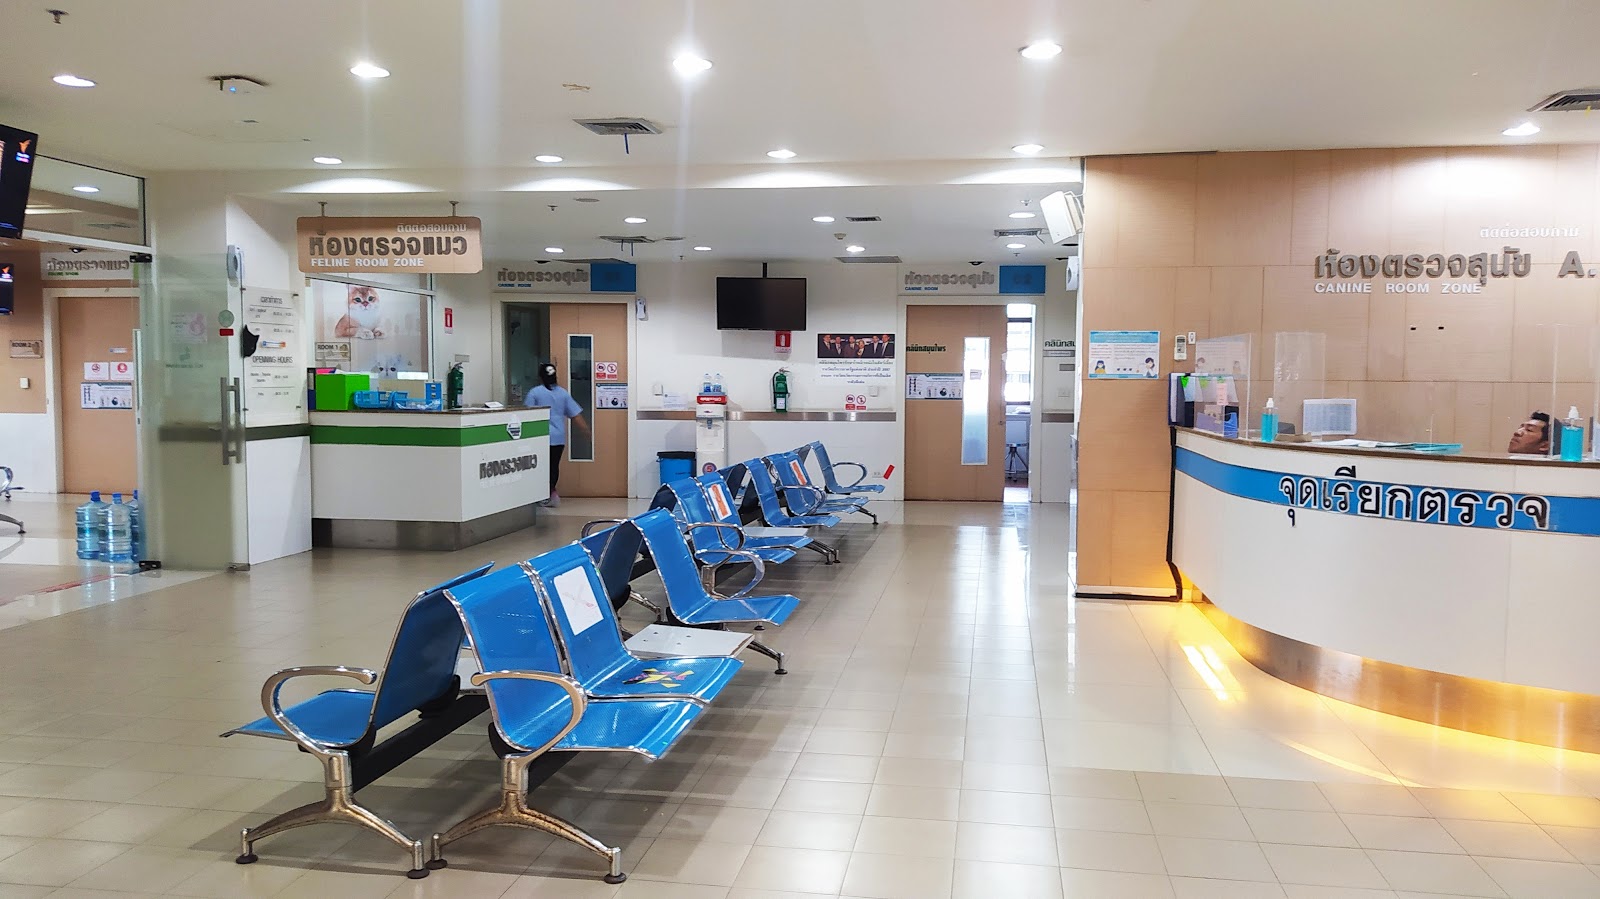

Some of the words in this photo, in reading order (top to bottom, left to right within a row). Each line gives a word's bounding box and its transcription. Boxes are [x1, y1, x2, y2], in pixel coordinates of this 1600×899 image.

[309, 231, 467, 256] ห้องตรวจแมว
[311, 257, 350, 267] FELINE
[355, 257, 389, 267] ROOM
[394, 257, 424, 267] ZONE
[1314, 246, 1532, 286] ห้องตรวจสุนัข
[1314, 282, 1372, 293] CANINE
[1385, 282, 1430, 294] ROOM
[1441, 282, 1482, 294] ZONE
[1278, 465, 1552, 528] จุดเรียกตรวจ
